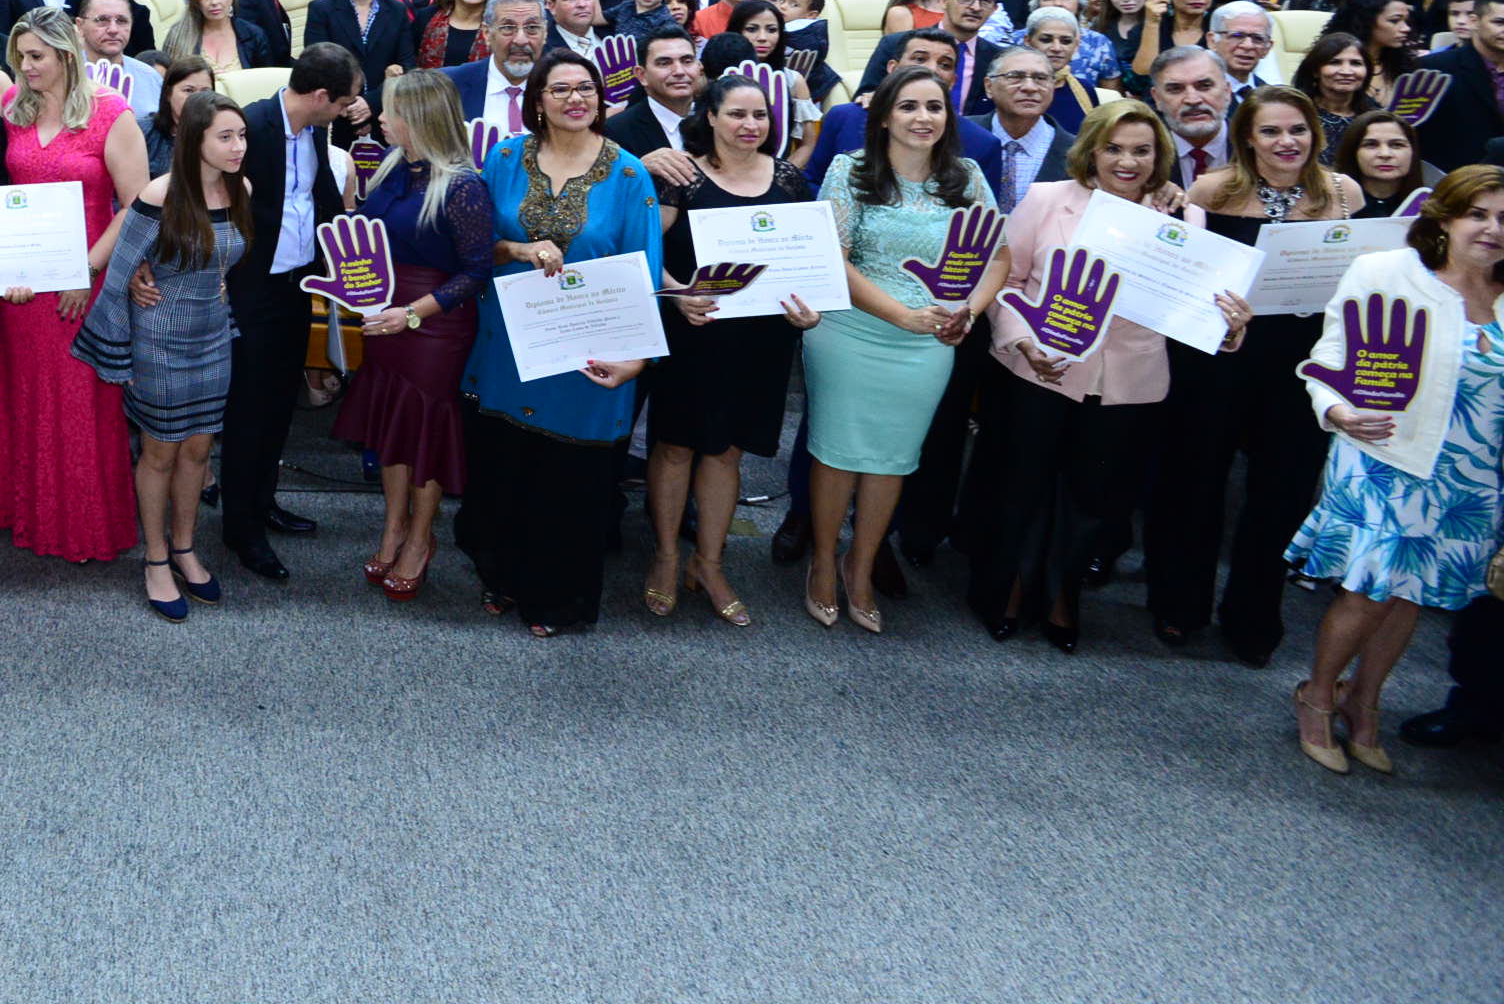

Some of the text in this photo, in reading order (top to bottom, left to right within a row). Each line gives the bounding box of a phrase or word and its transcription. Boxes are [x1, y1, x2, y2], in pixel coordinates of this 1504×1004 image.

[347, 258, 373, 267] minha
[341, 266, 369, 275] Família
[355, 278, 383, 288] Senhor
[1053, 294, 1089, 311] O amor
[1050, 302, 1094, 322] da pátria
[1044, 316, 1078, 334] Família
[1047, 311, 1096, 331] começa na
[1356, 349, 1400, 360] O amor
[1355, 358, 1409, 370] da pátria
[1354, 369, 1414, 380] começa na
[1354, 376, 1396, 388] Família
